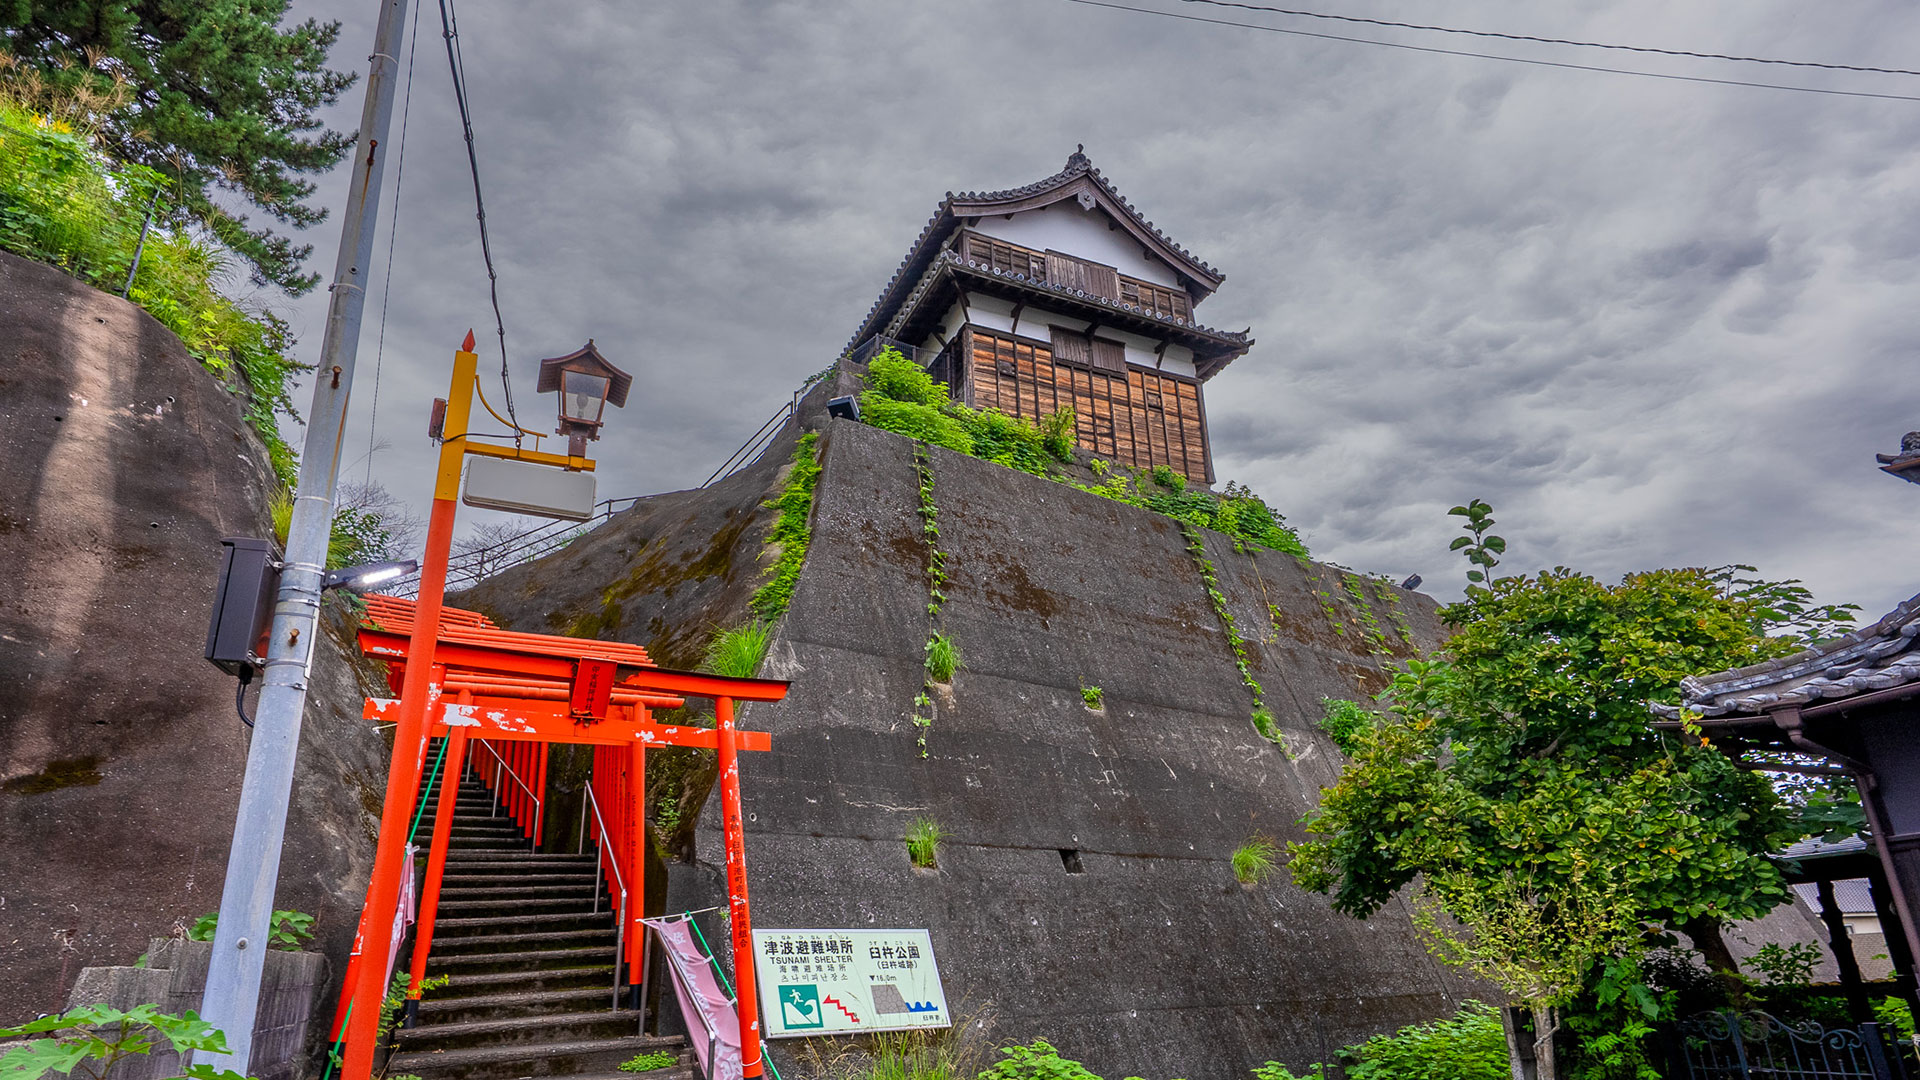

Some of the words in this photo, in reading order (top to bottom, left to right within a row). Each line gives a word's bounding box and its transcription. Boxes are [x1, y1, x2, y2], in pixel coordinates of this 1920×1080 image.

[764, 940, 853, 955] 津波避難場所
[869, 945, 920, 959] 臼杵公園
[770, 956, 810, 965] TSUNAMI
[814, 955, 853, 964] SHELTER
